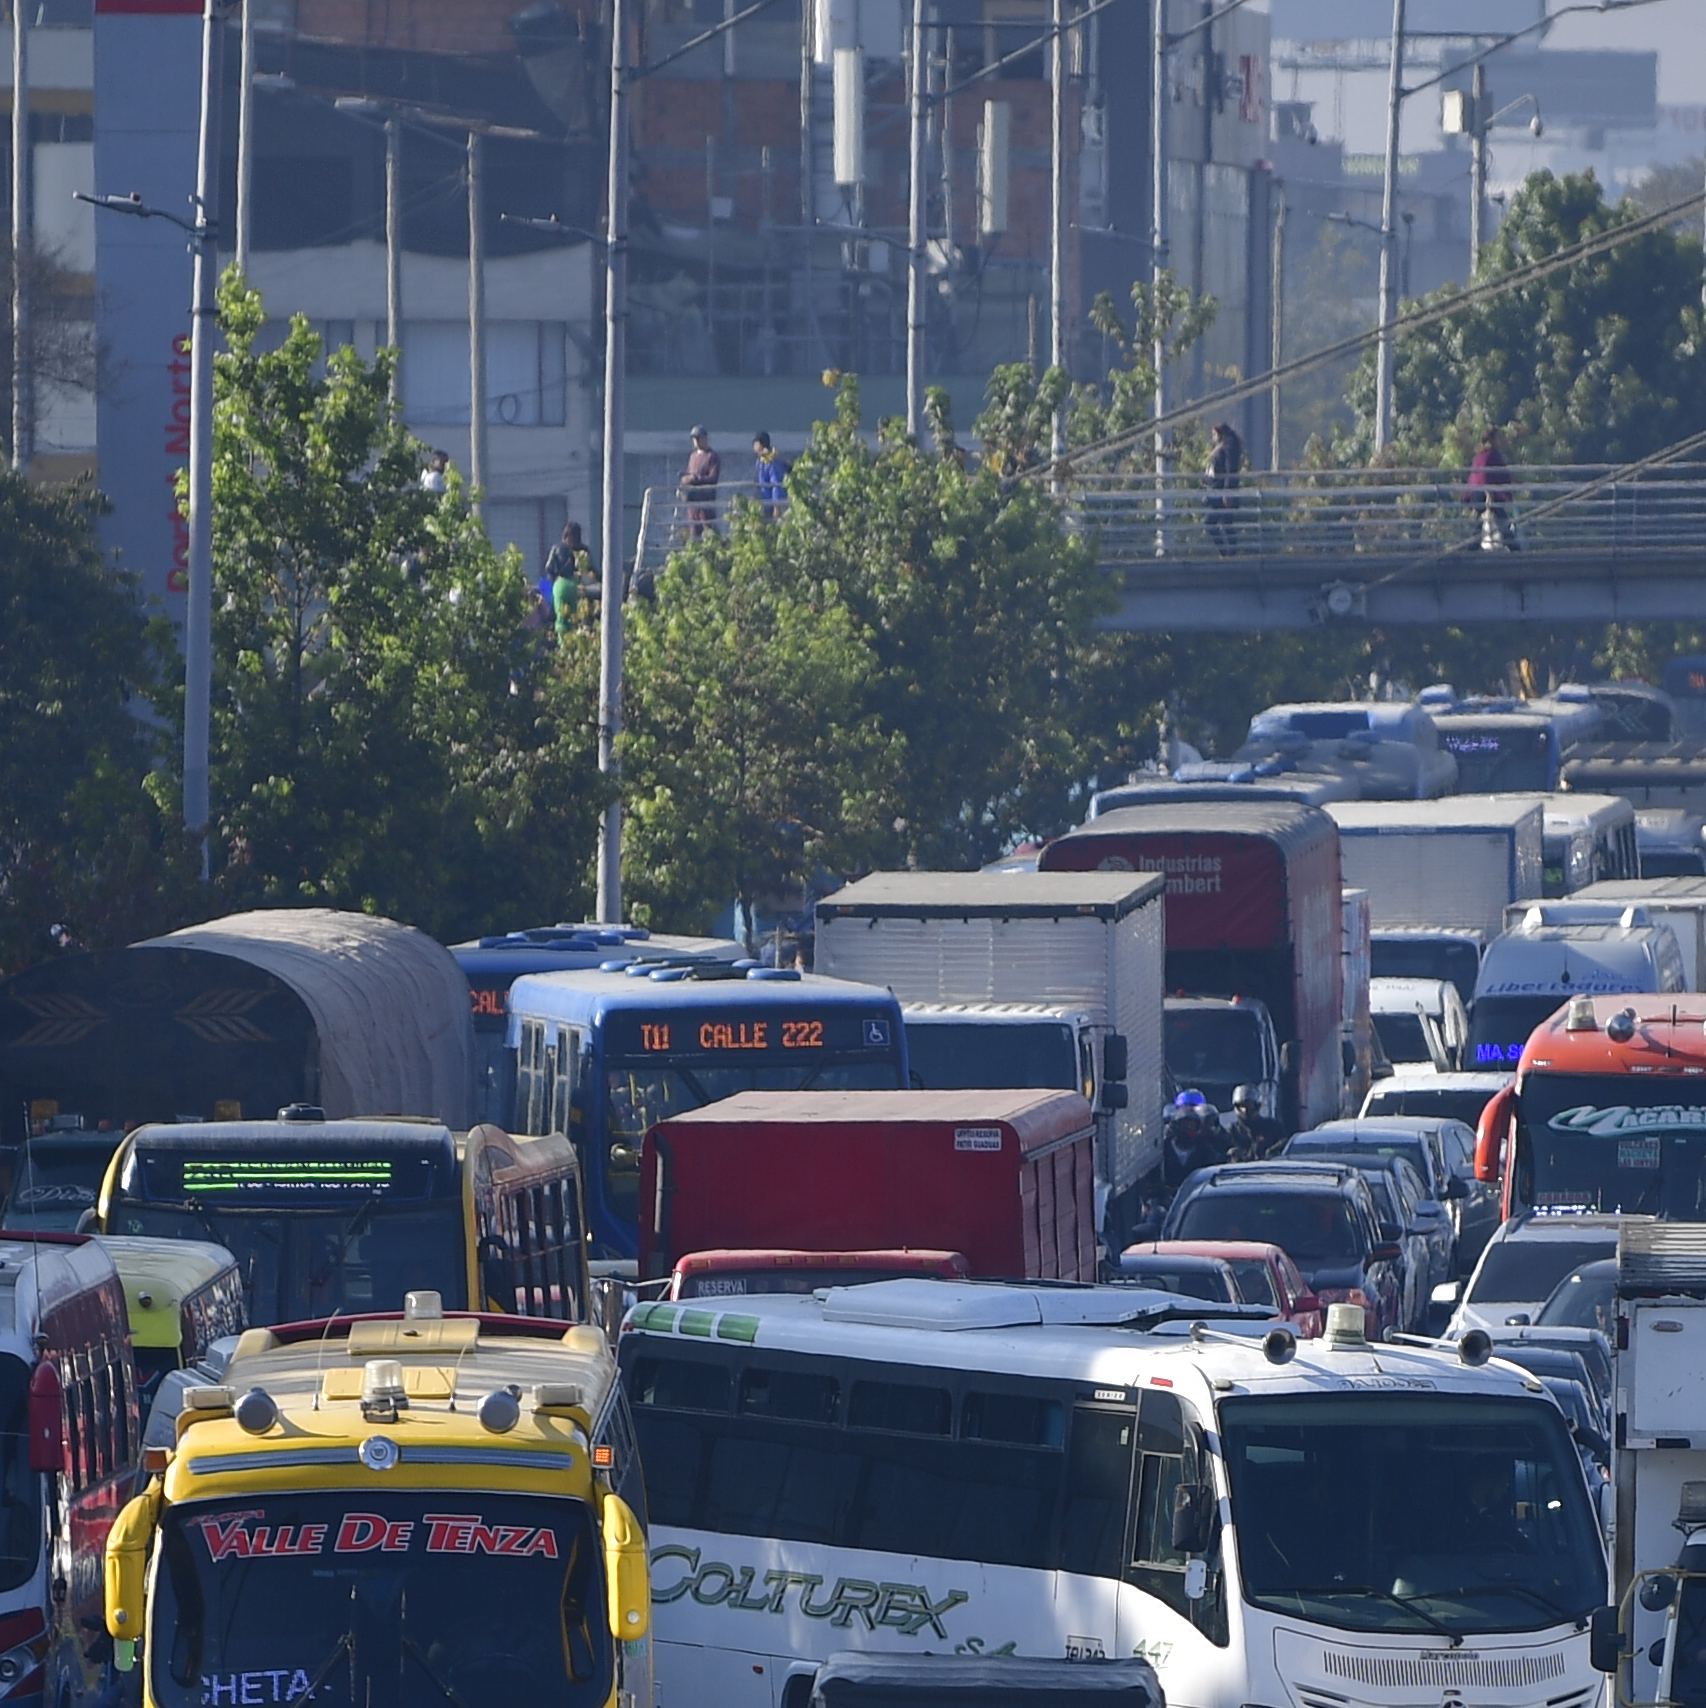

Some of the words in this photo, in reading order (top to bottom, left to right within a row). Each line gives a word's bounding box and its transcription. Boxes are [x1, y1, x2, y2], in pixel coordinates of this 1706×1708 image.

[166, 474, 189, 593] Port
[1139, 855, 1222, 873] Industrias
[1165, 875, 1221, 893] mbert
[469, 990, 504, 1015] CAL
[699, 1022, 768, 1049] CALLE
[782, 1020, 824, 1047] 222
[697, 1279, 745, 1295] RESERVA
[202, 1520, 328, 1562] VALLE
[423, 1514, 559, 1559] TENZA
[649, 1543, 970, 1640] COLTUREX
[1133, 1638, 1173, 1666] 447
